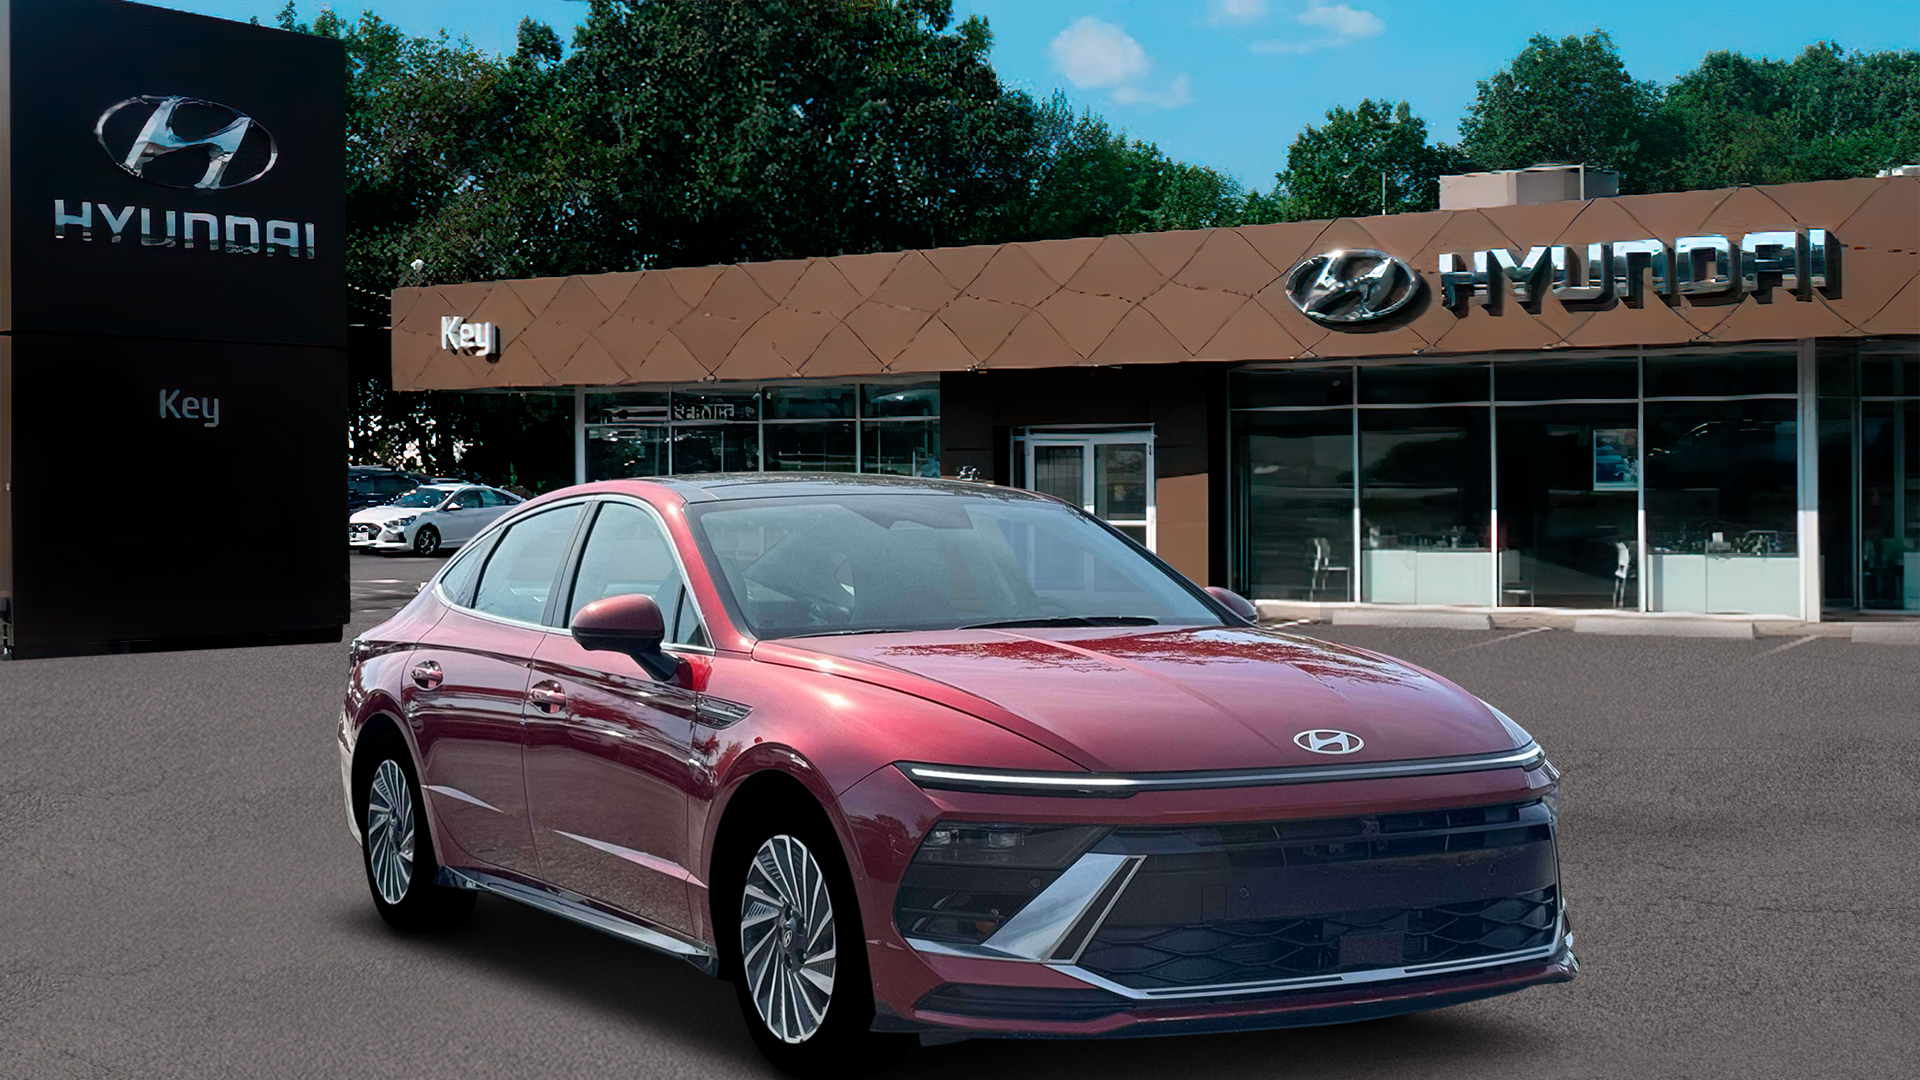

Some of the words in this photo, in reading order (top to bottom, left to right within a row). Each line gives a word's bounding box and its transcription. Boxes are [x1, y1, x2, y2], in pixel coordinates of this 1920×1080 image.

[54, 199, 315, 259] HYUNDAI
[1438, 228, 1840, 307] HYUNDAI
[441, 315, 495, 357] Key
[159, 388, 220, 427] Key
